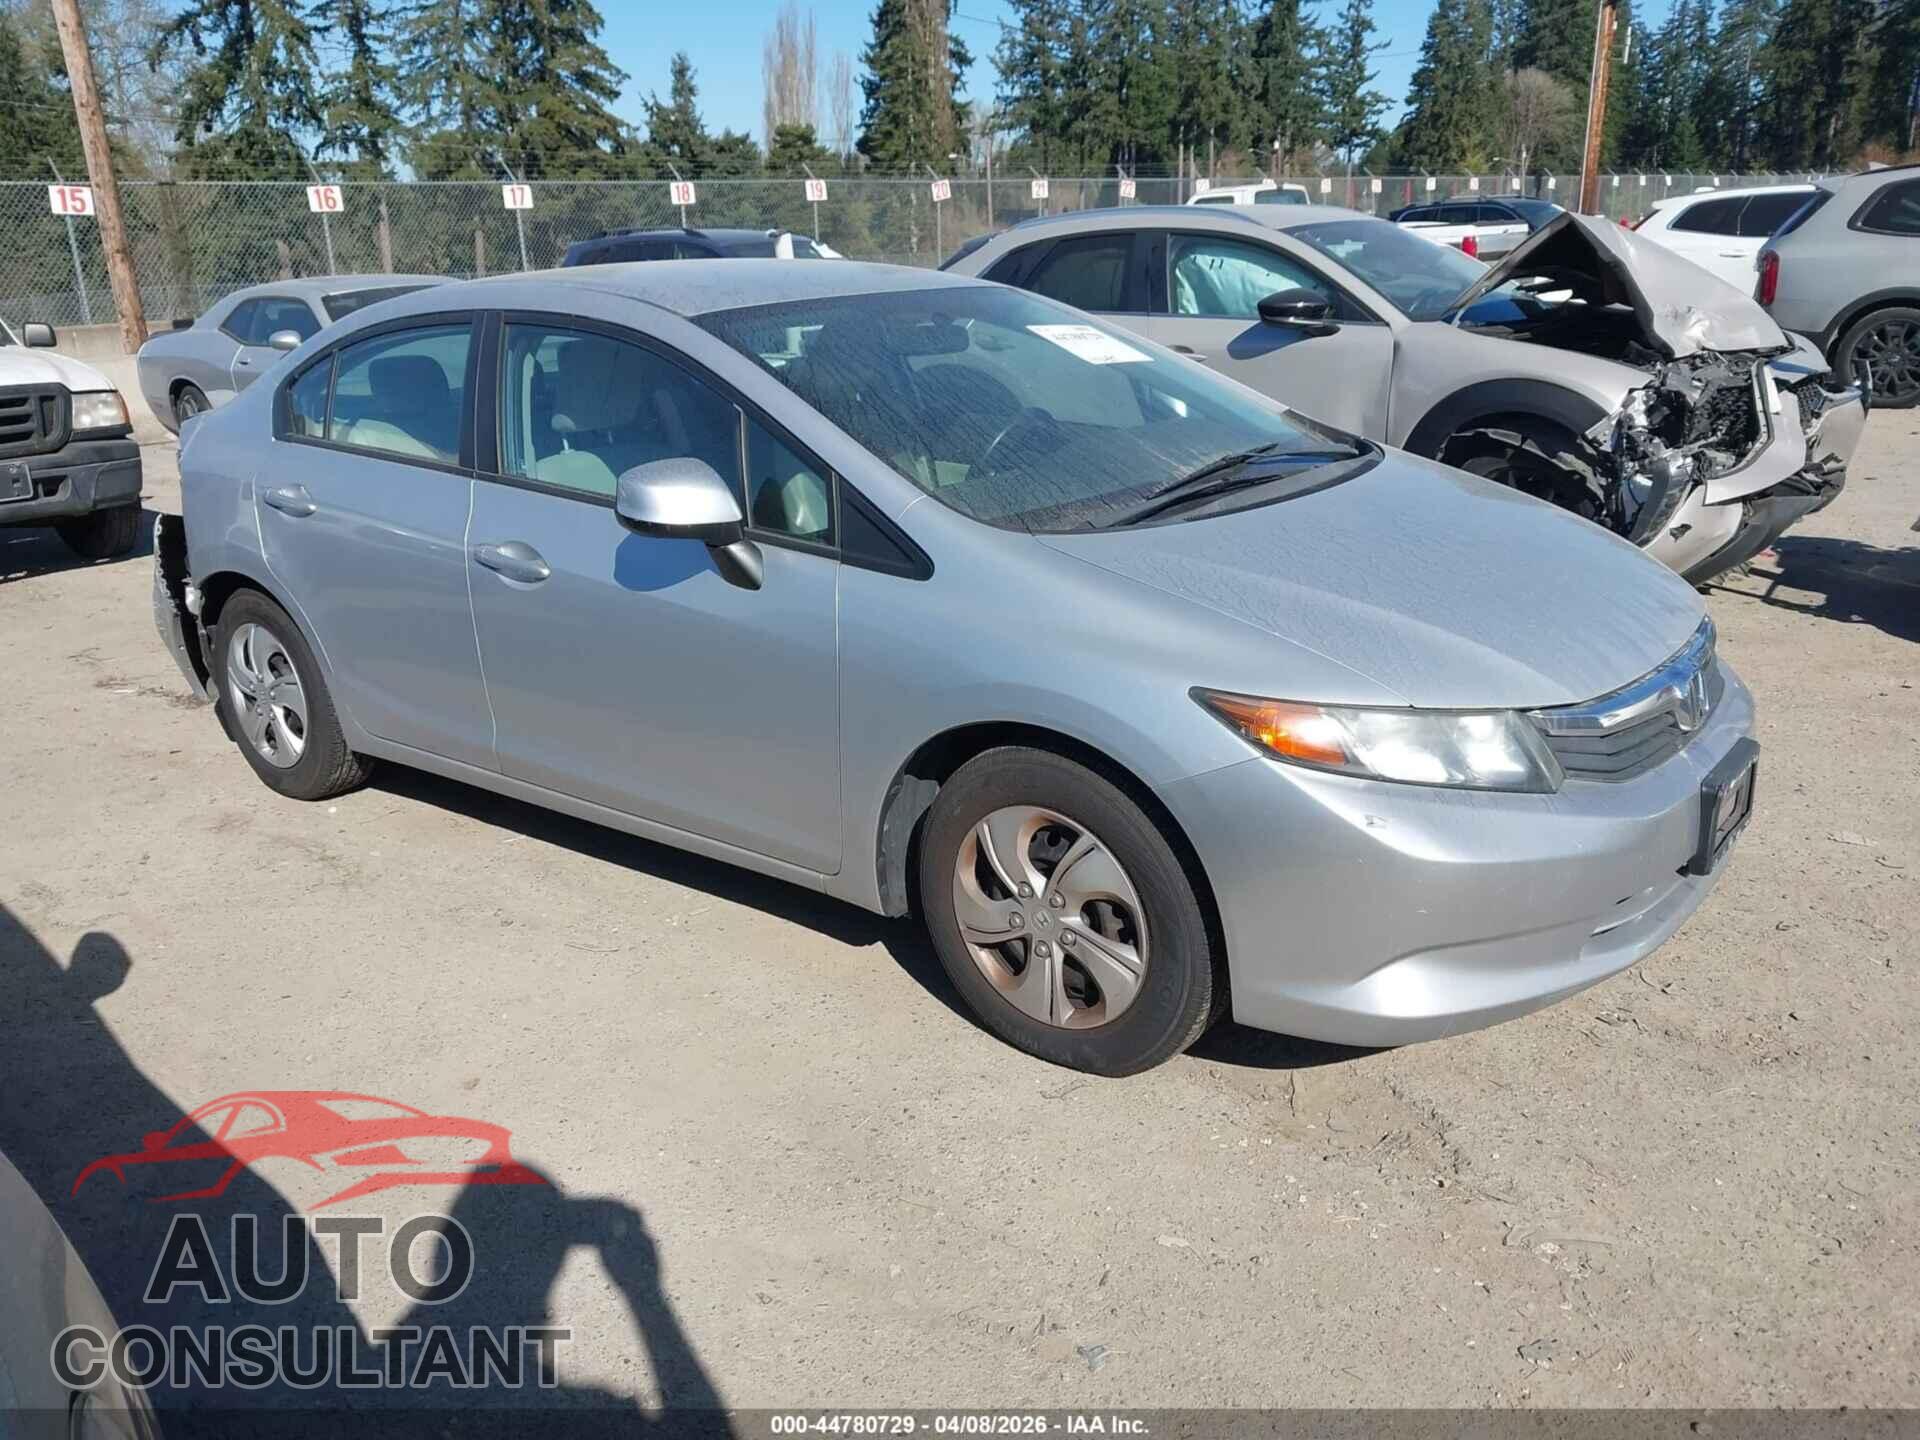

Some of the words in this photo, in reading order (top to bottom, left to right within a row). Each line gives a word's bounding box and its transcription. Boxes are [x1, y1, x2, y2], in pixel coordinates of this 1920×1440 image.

[56, 188, 86, 213] 15
[314, 187, 337, 210] 16
[510, 186, 525, 206] 17
[674, 183, 690, 203] 18
[810, 182, 823, 199] 19
